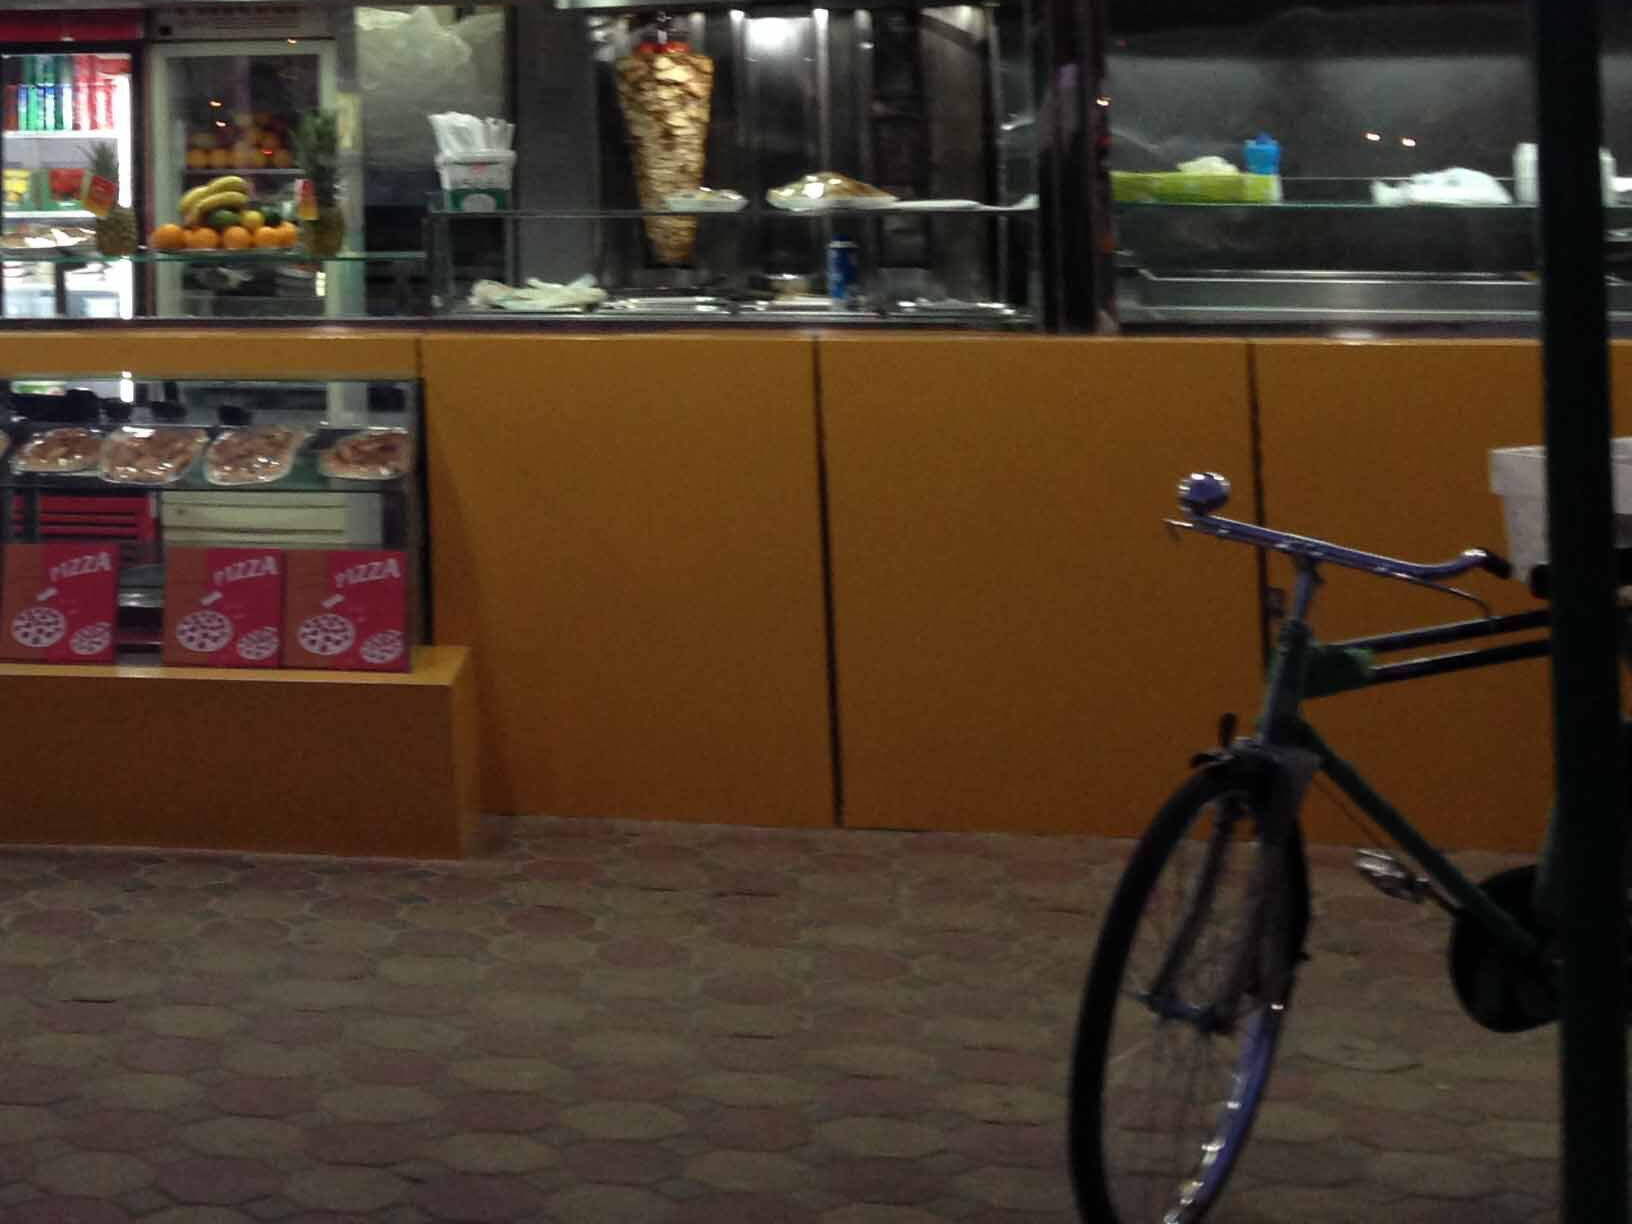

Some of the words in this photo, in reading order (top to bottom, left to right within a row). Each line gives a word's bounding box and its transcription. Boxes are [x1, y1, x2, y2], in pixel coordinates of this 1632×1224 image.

[48, 551, 113, 583] PIZZA
[212, 555, 281, 587] PIZZA
[334, 557, 402, 588] PIZZA
